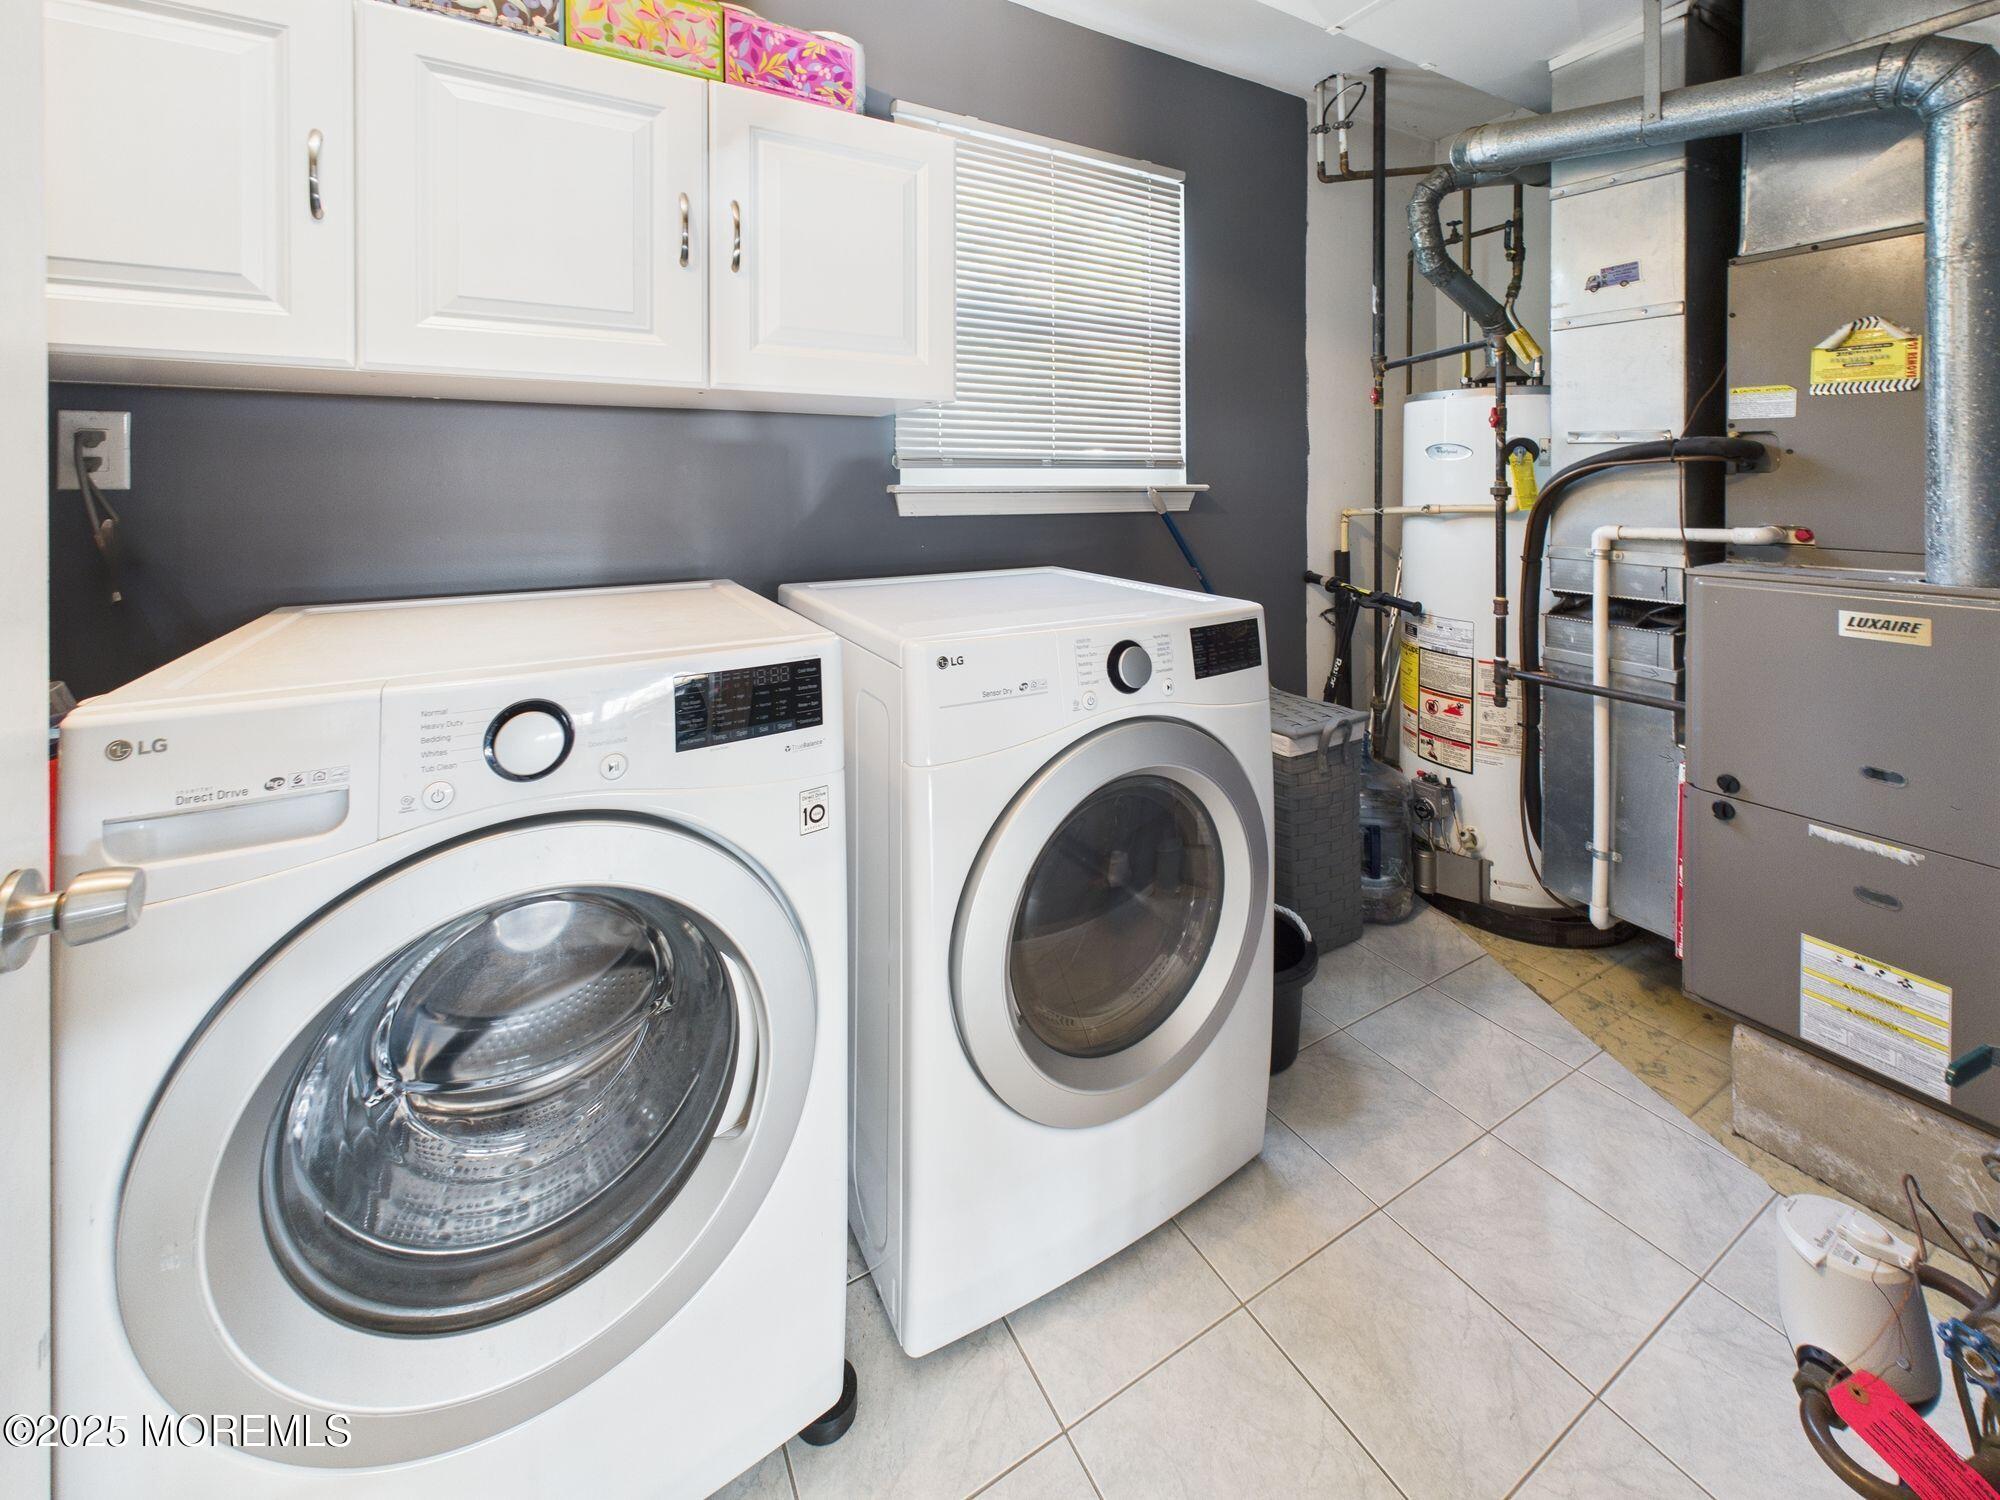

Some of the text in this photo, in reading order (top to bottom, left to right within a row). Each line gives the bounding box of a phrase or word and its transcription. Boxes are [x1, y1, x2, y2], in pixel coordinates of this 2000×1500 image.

[1847, 616, 1922, 634] LUXAIRE
[951, 656, 964, 666] LG
[982, 690, 1001, 698] Sensor
[421, 708, 448, 717] Normal
[446, 720, 464, 728] Duty
[420, 735, 451, 744] Bedding
[138, 738, 168, 755] LG
[421, 750, 448, 758] Whites
[421, 765, 435, 773] Tub
[176, 787, 249, 806] Direct Drive
[803, 804, 825, 826] 10
